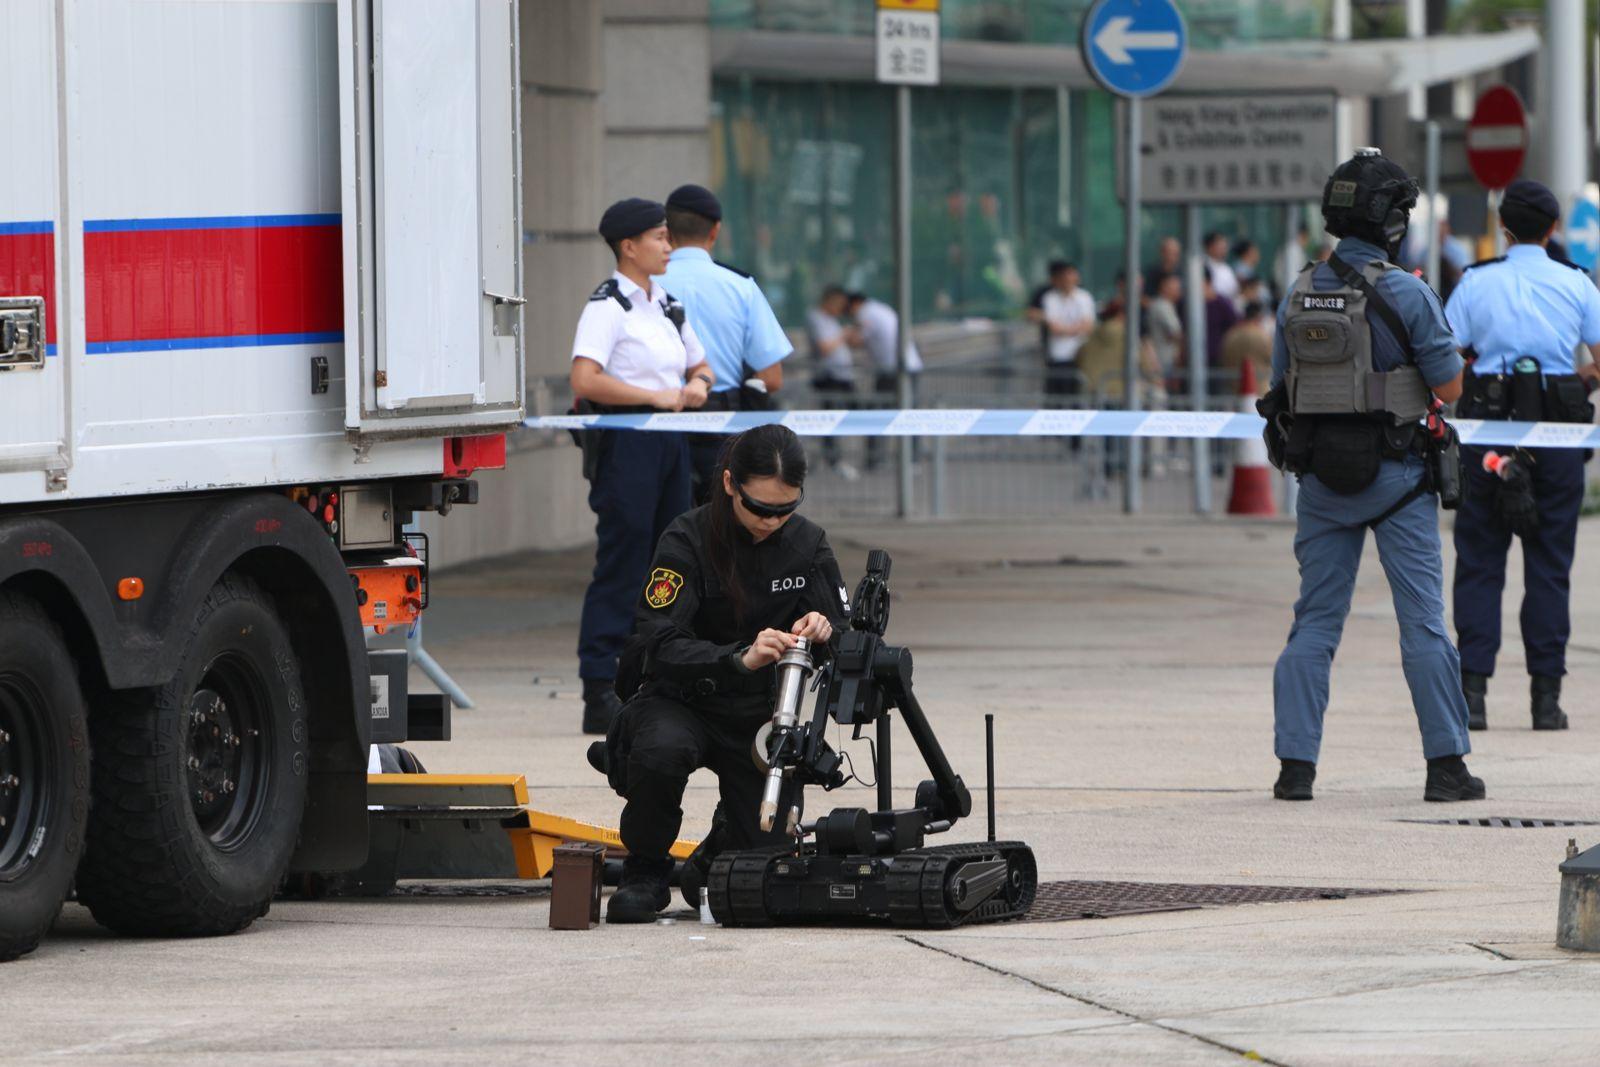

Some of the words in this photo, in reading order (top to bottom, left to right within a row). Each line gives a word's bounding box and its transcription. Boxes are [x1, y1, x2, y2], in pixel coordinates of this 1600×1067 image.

[884, 17, 904, 38] 24
[908, 22, 931, 39] hrs
[1311, 297, 1336, 308] POLICE
[771, 576, 806, 592] E.O.D
